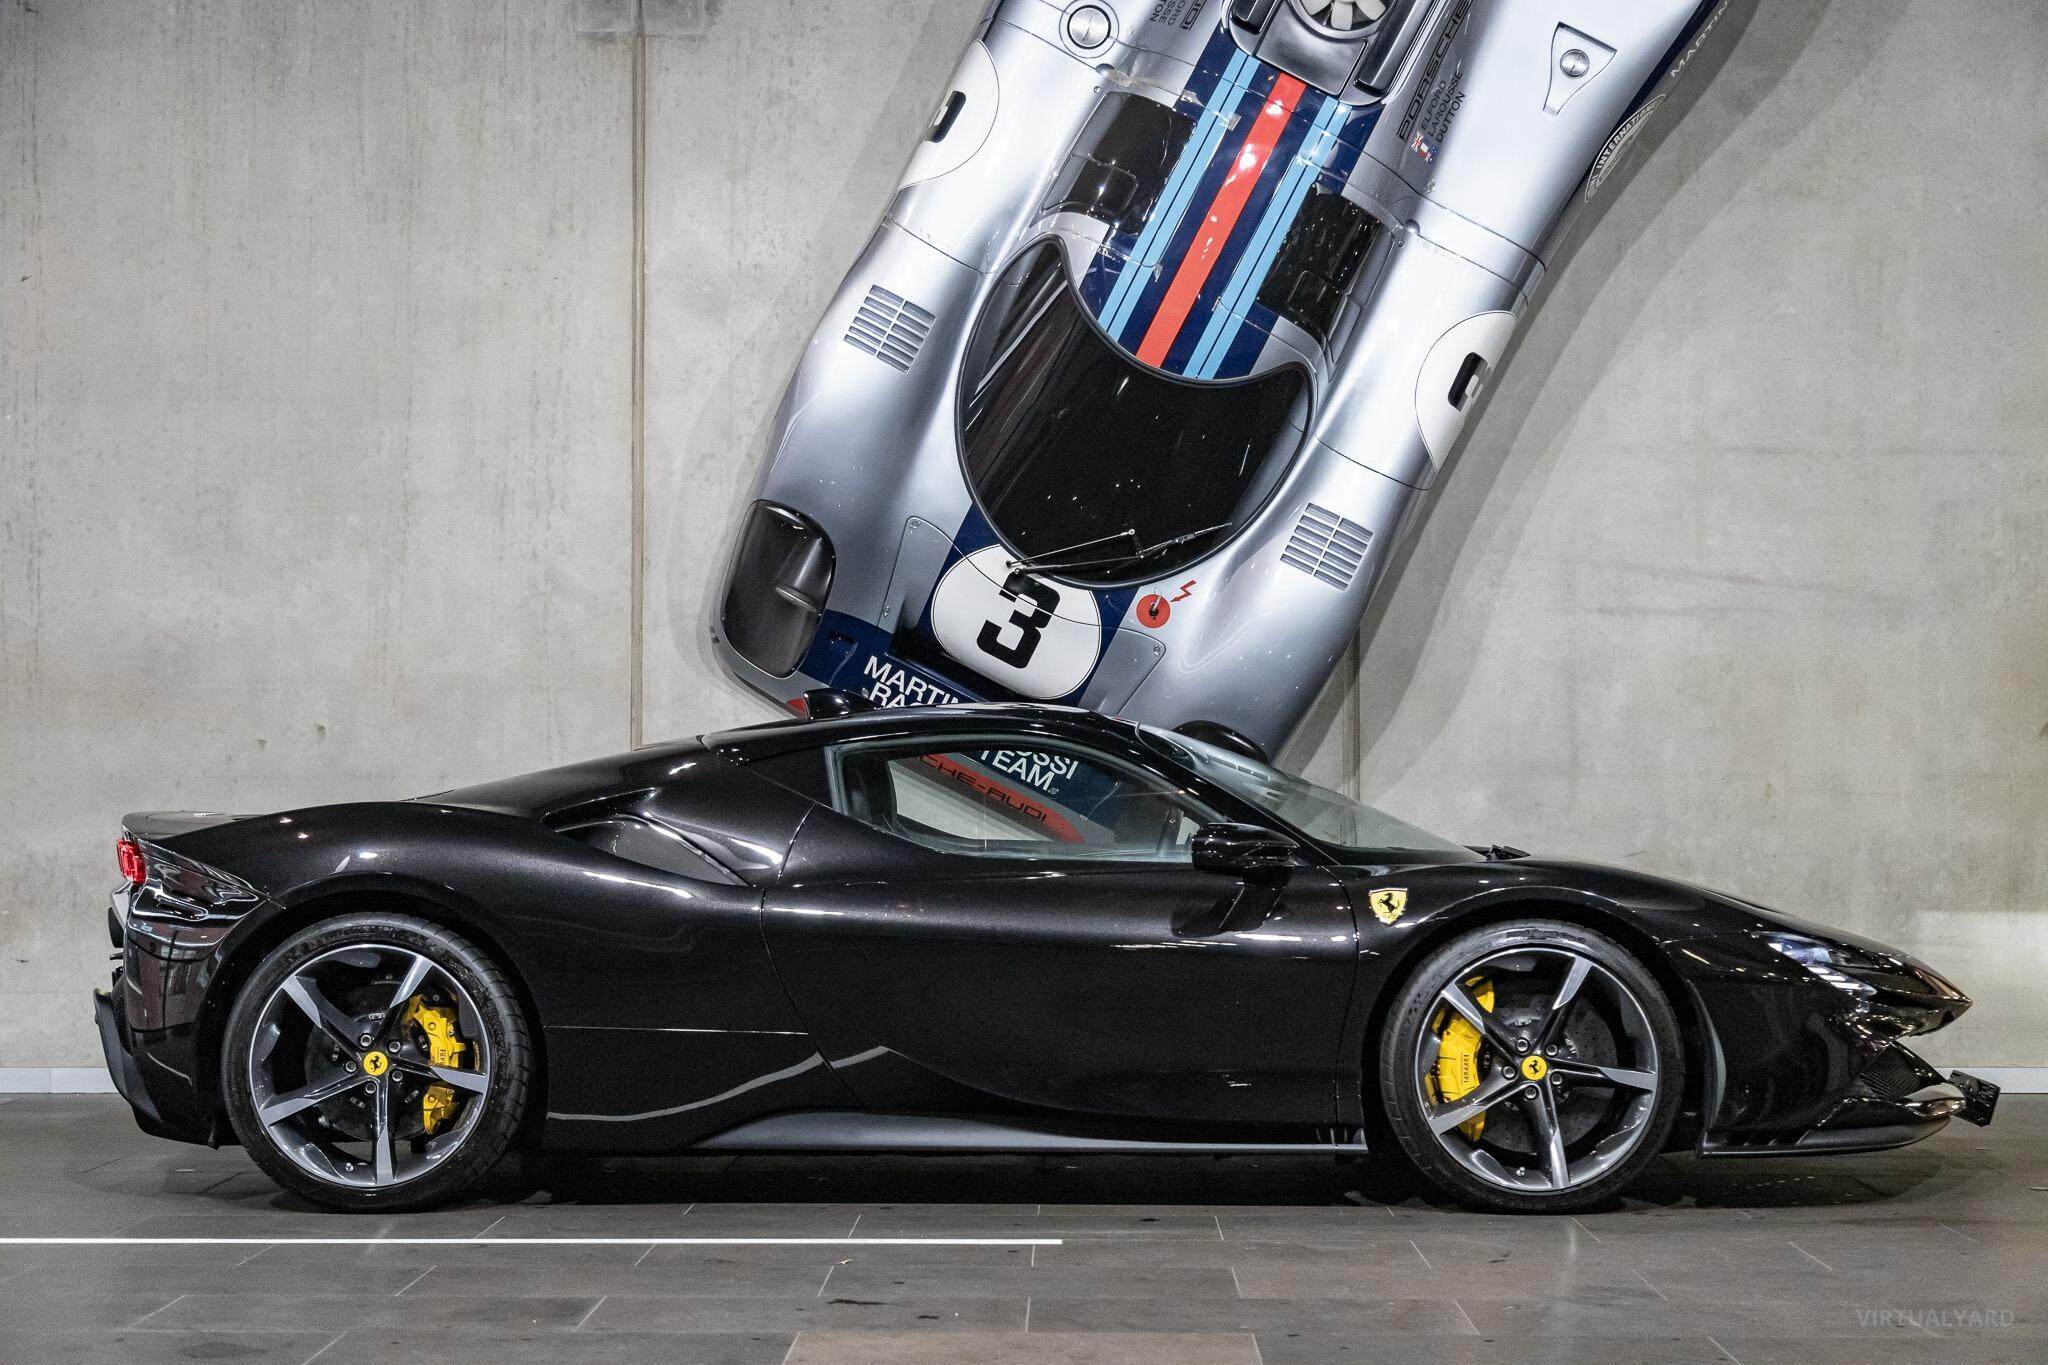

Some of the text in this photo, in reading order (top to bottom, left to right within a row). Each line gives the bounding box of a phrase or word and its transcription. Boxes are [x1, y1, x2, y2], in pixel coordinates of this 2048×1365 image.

[1421, 80, 1446, 130] ELFORD
[1428, 71, 1463, 137] LAROUSSE
[1436, 91, 1467, 143] DUTTON
[976, 571, 1061, 669] 3
[869, 681, 923, 708] RA
[1016, 750, 1079, 780] SSI
